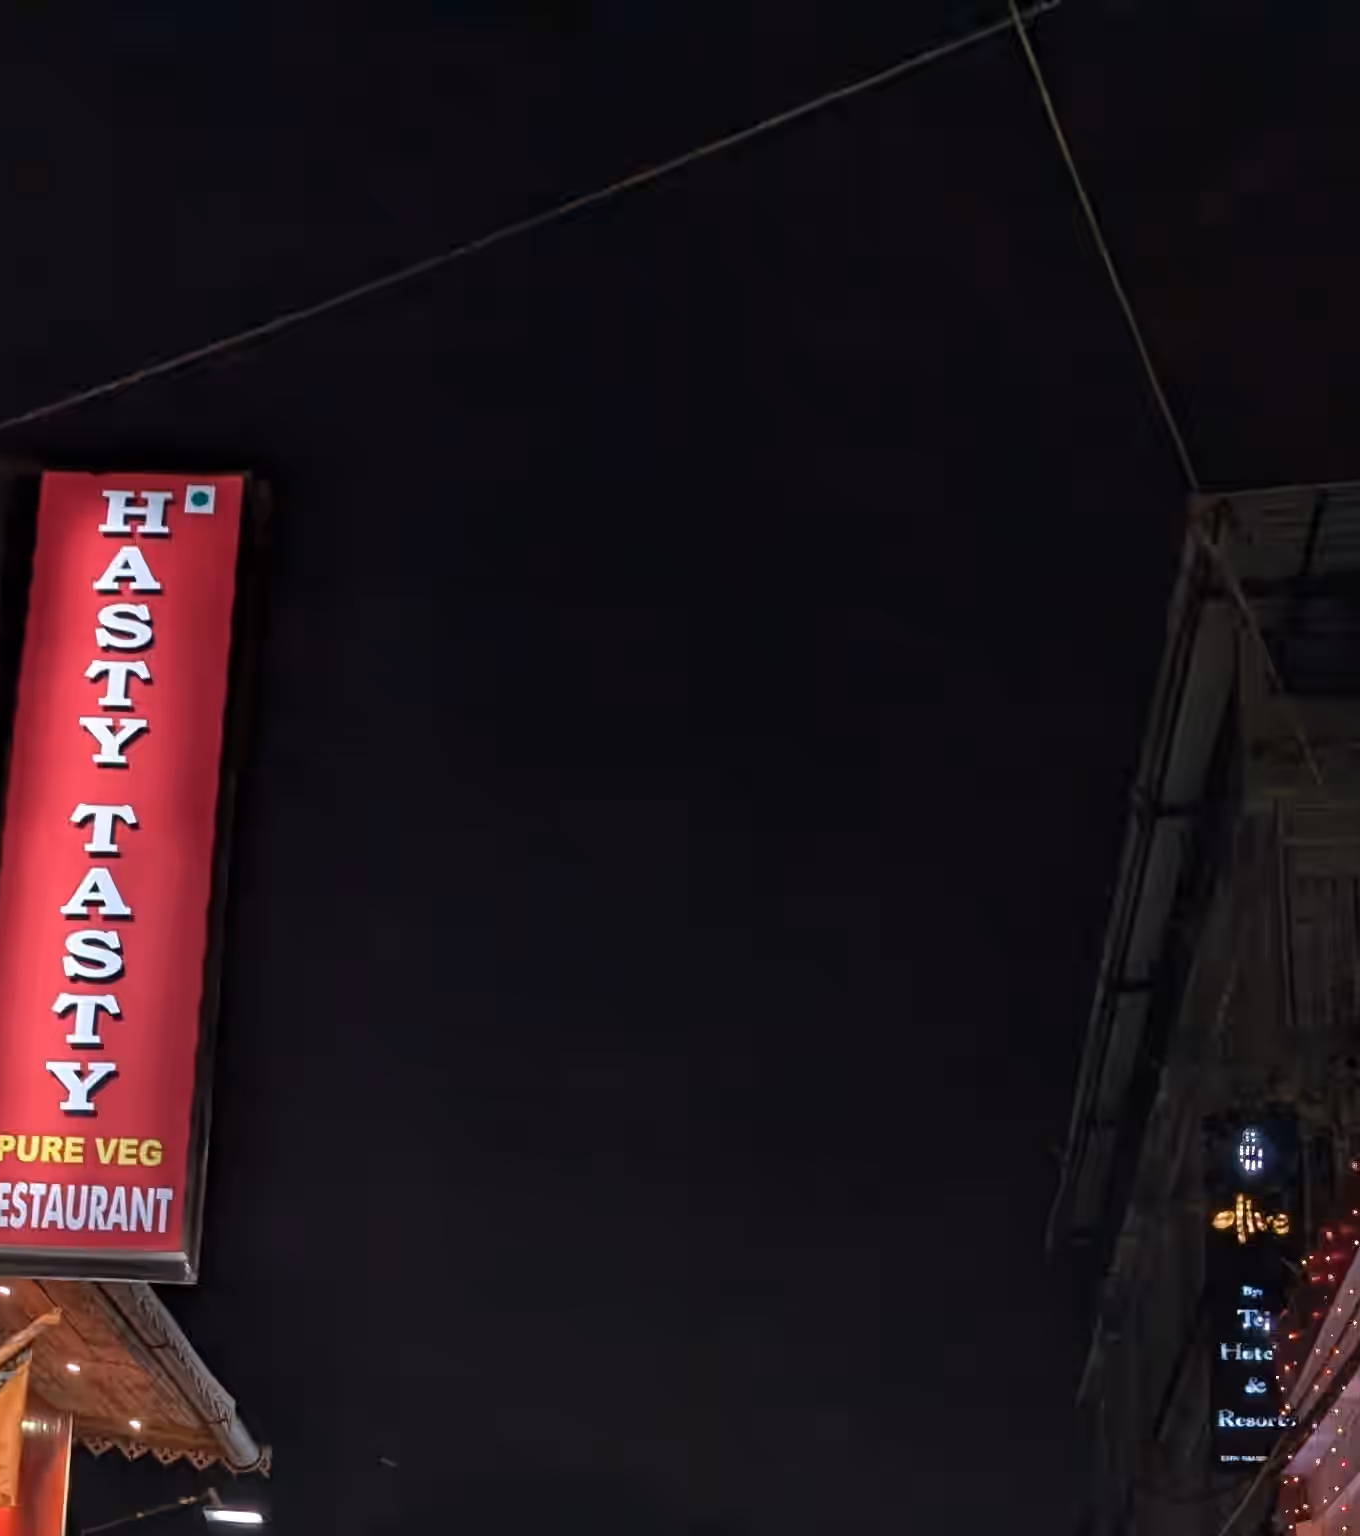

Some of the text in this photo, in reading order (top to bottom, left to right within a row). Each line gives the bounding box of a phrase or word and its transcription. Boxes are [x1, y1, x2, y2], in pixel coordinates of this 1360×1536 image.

[79, 490, 172, 767] HASTY
[46, 803, 139, 1115] TASTY
[96, 1138, 162, 1166] VEG
[1244, 1377, 1267, 1394] &
